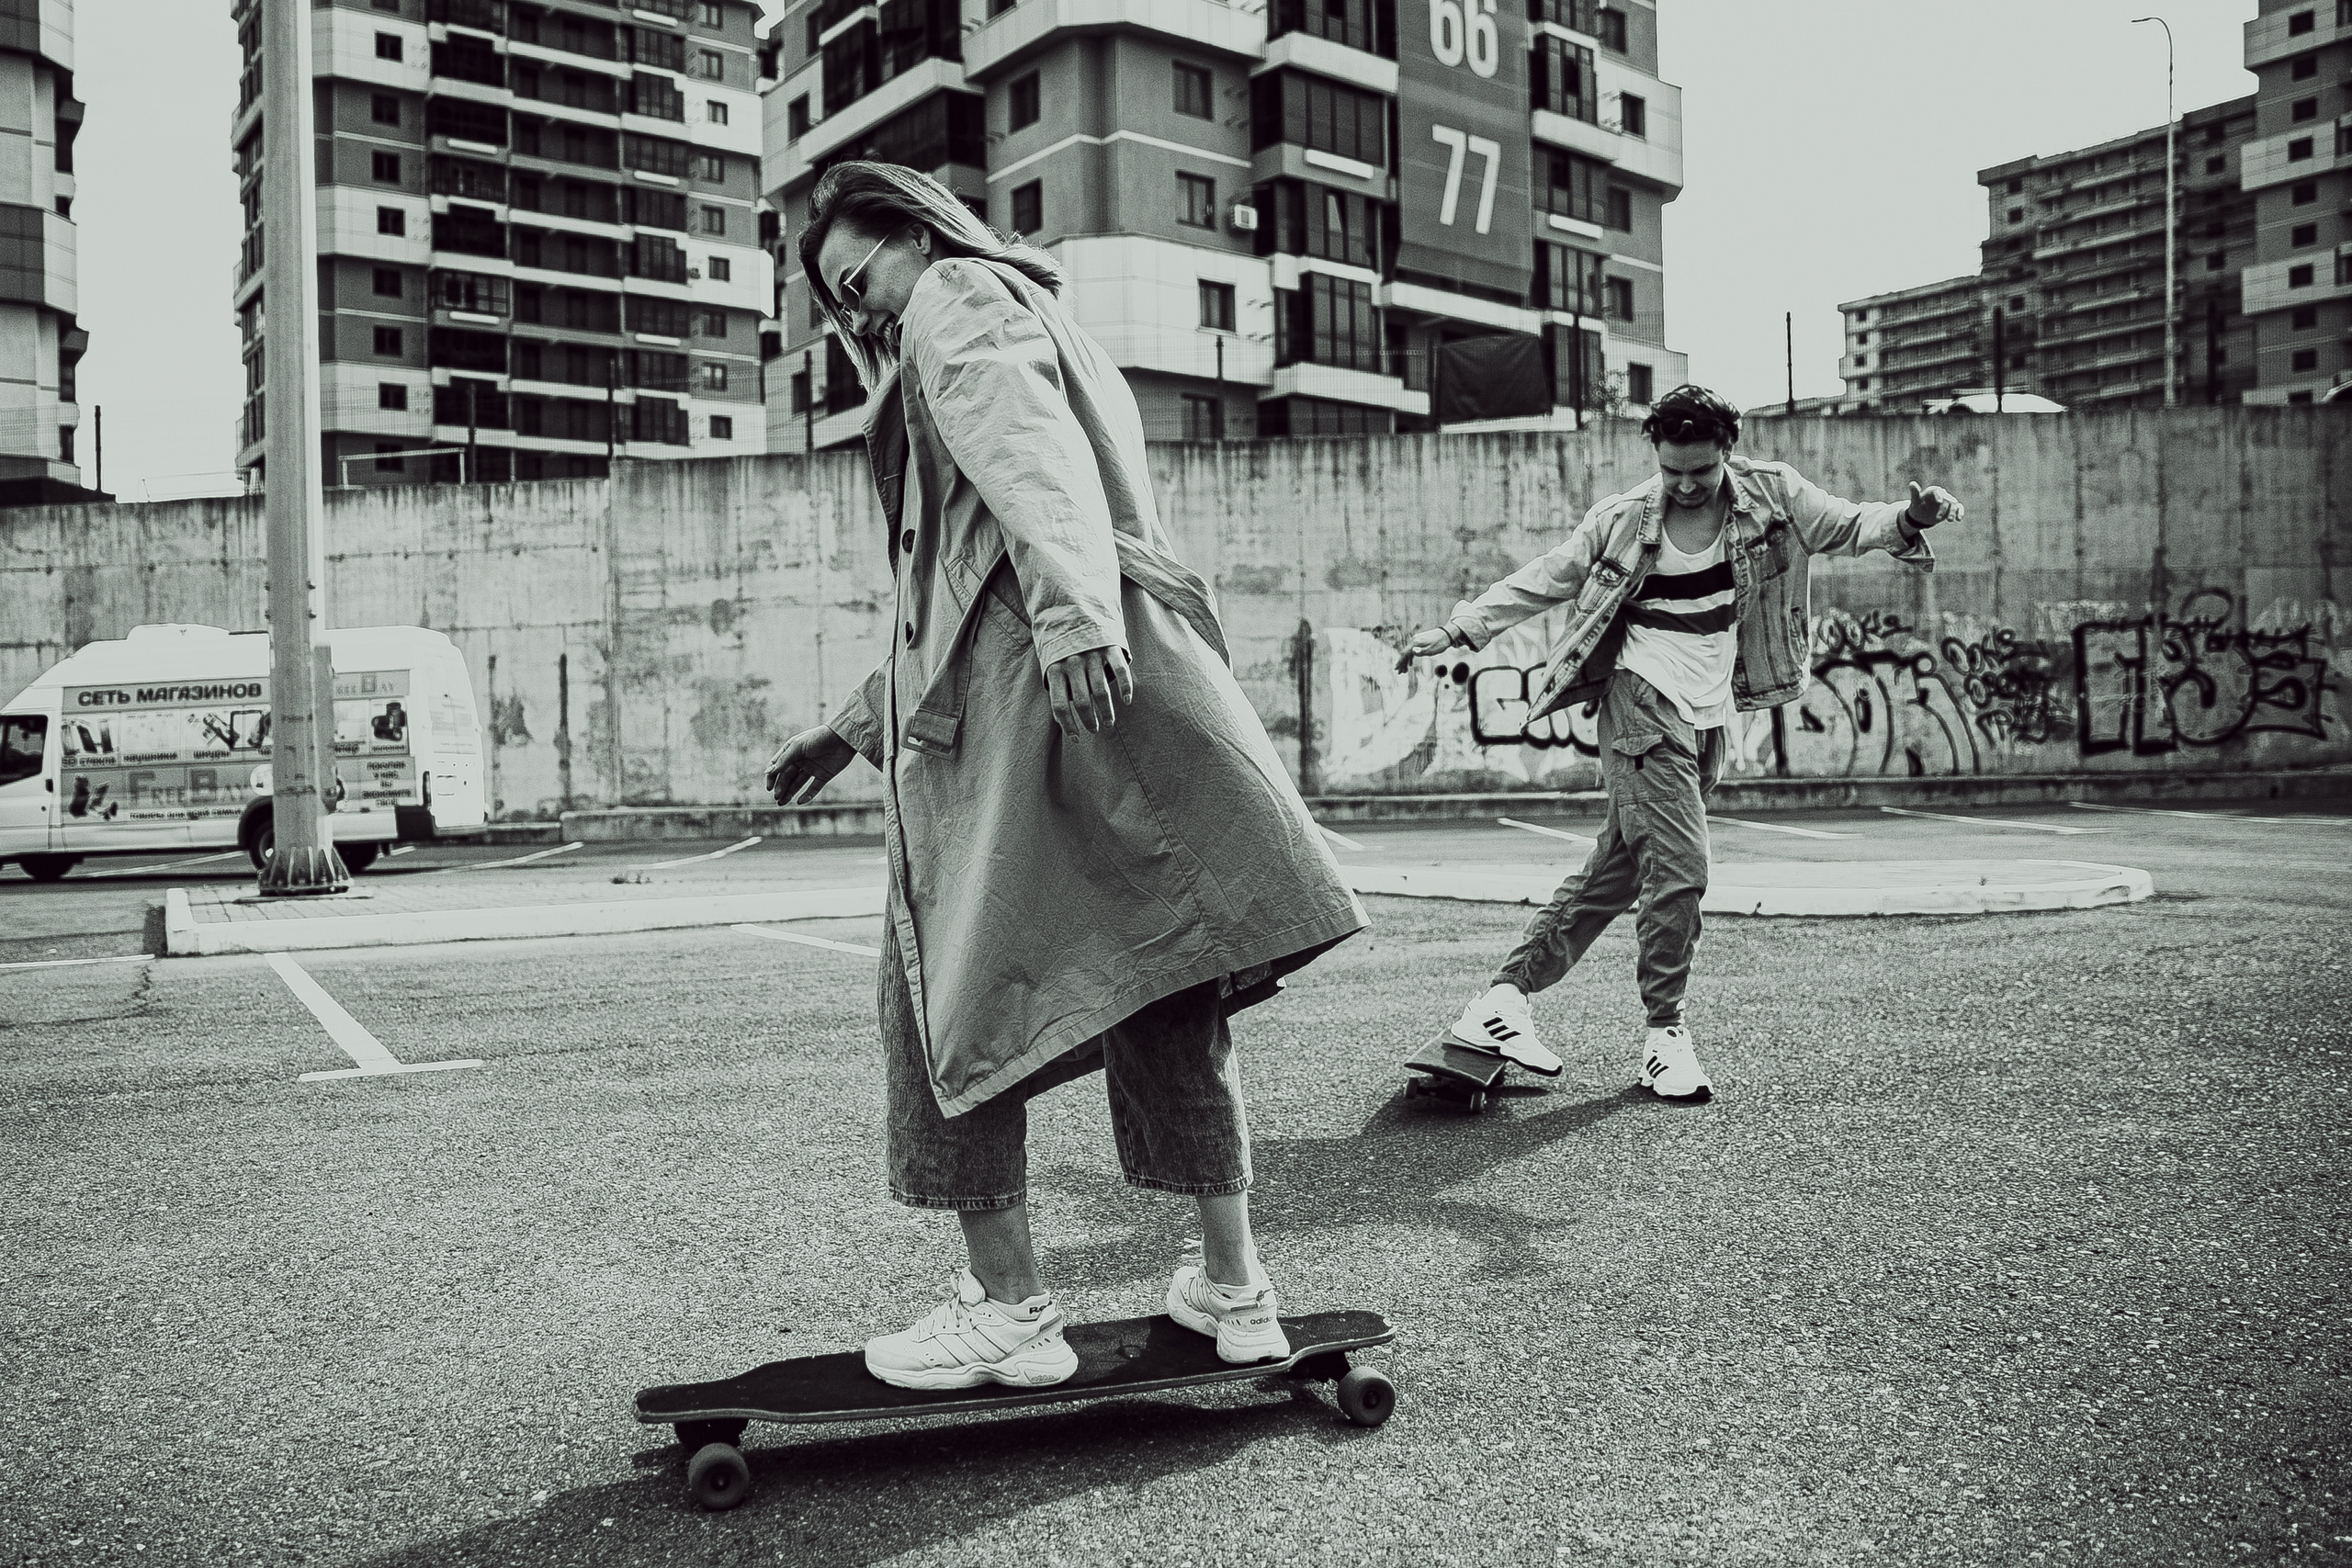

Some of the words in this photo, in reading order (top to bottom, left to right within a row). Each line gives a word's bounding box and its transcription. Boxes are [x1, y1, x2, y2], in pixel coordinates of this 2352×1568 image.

[1430, 0, 1499, 78] 66
[1431, 123, 1501, 235] 77
[78, 690, 130, 706] СЕТЬ
[137, 683, 261, 703] МАГАЗИНОВ
